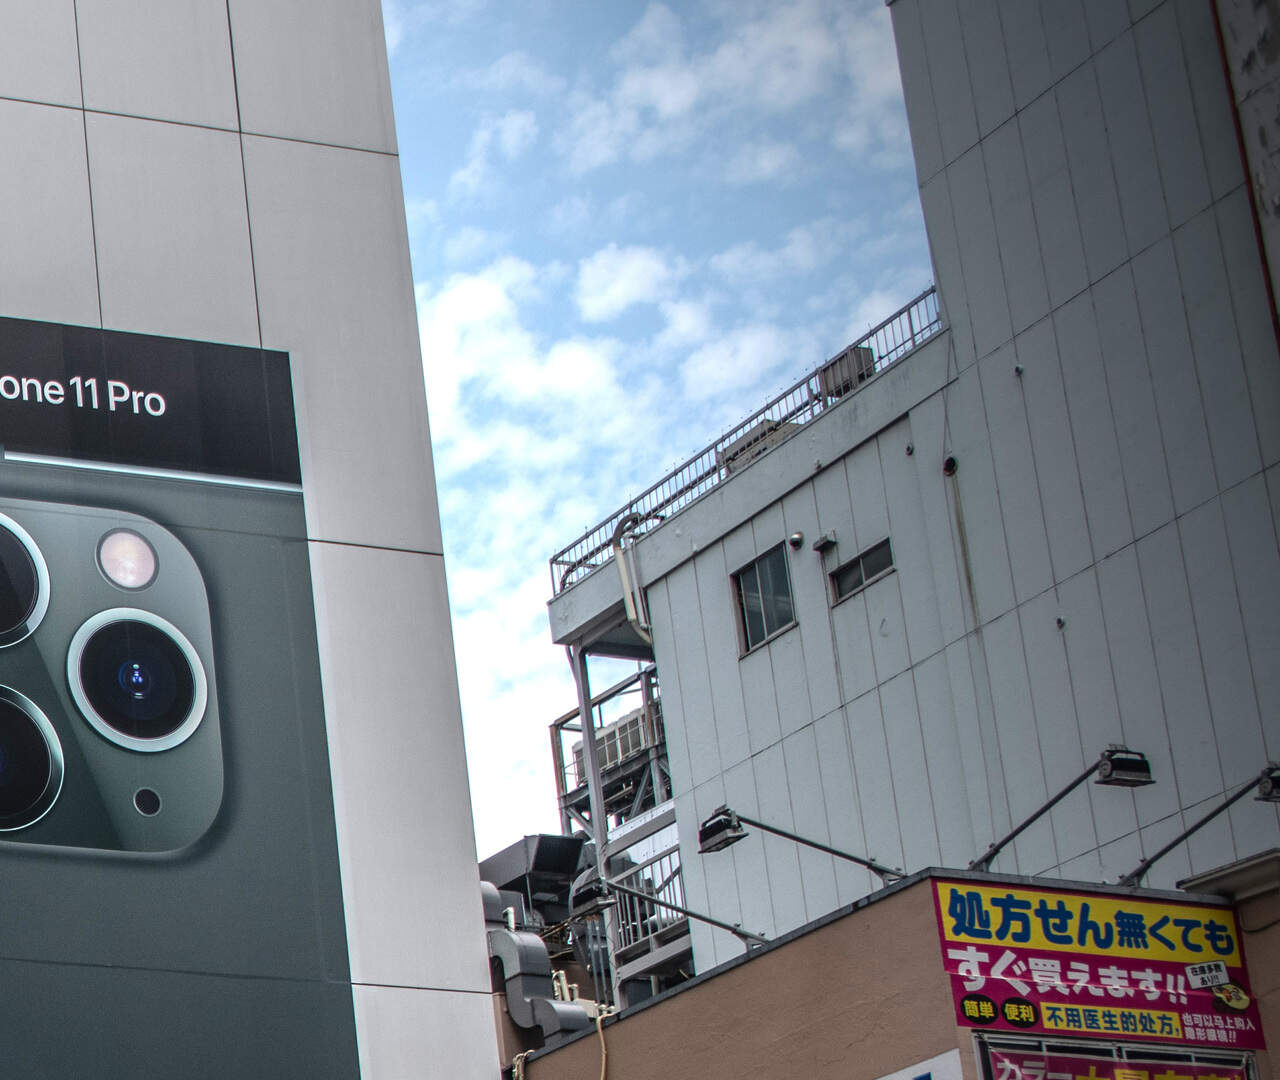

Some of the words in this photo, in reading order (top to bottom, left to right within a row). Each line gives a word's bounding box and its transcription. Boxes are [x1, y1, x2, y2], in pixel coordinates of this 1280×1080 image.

[69, 375, 98, 409] 11
[107, 380, 166, 417] Pro
[948, 887, 1236, 956] 処方せん無くても
[946, 945, 1188, 1006] すぐ買えます!!
[964, 998, 994, 1020] 簡単
[1003, 1001, 1036, 1023] 便利
[1182, 1011, 1256, 1032] 也可以马上购入
